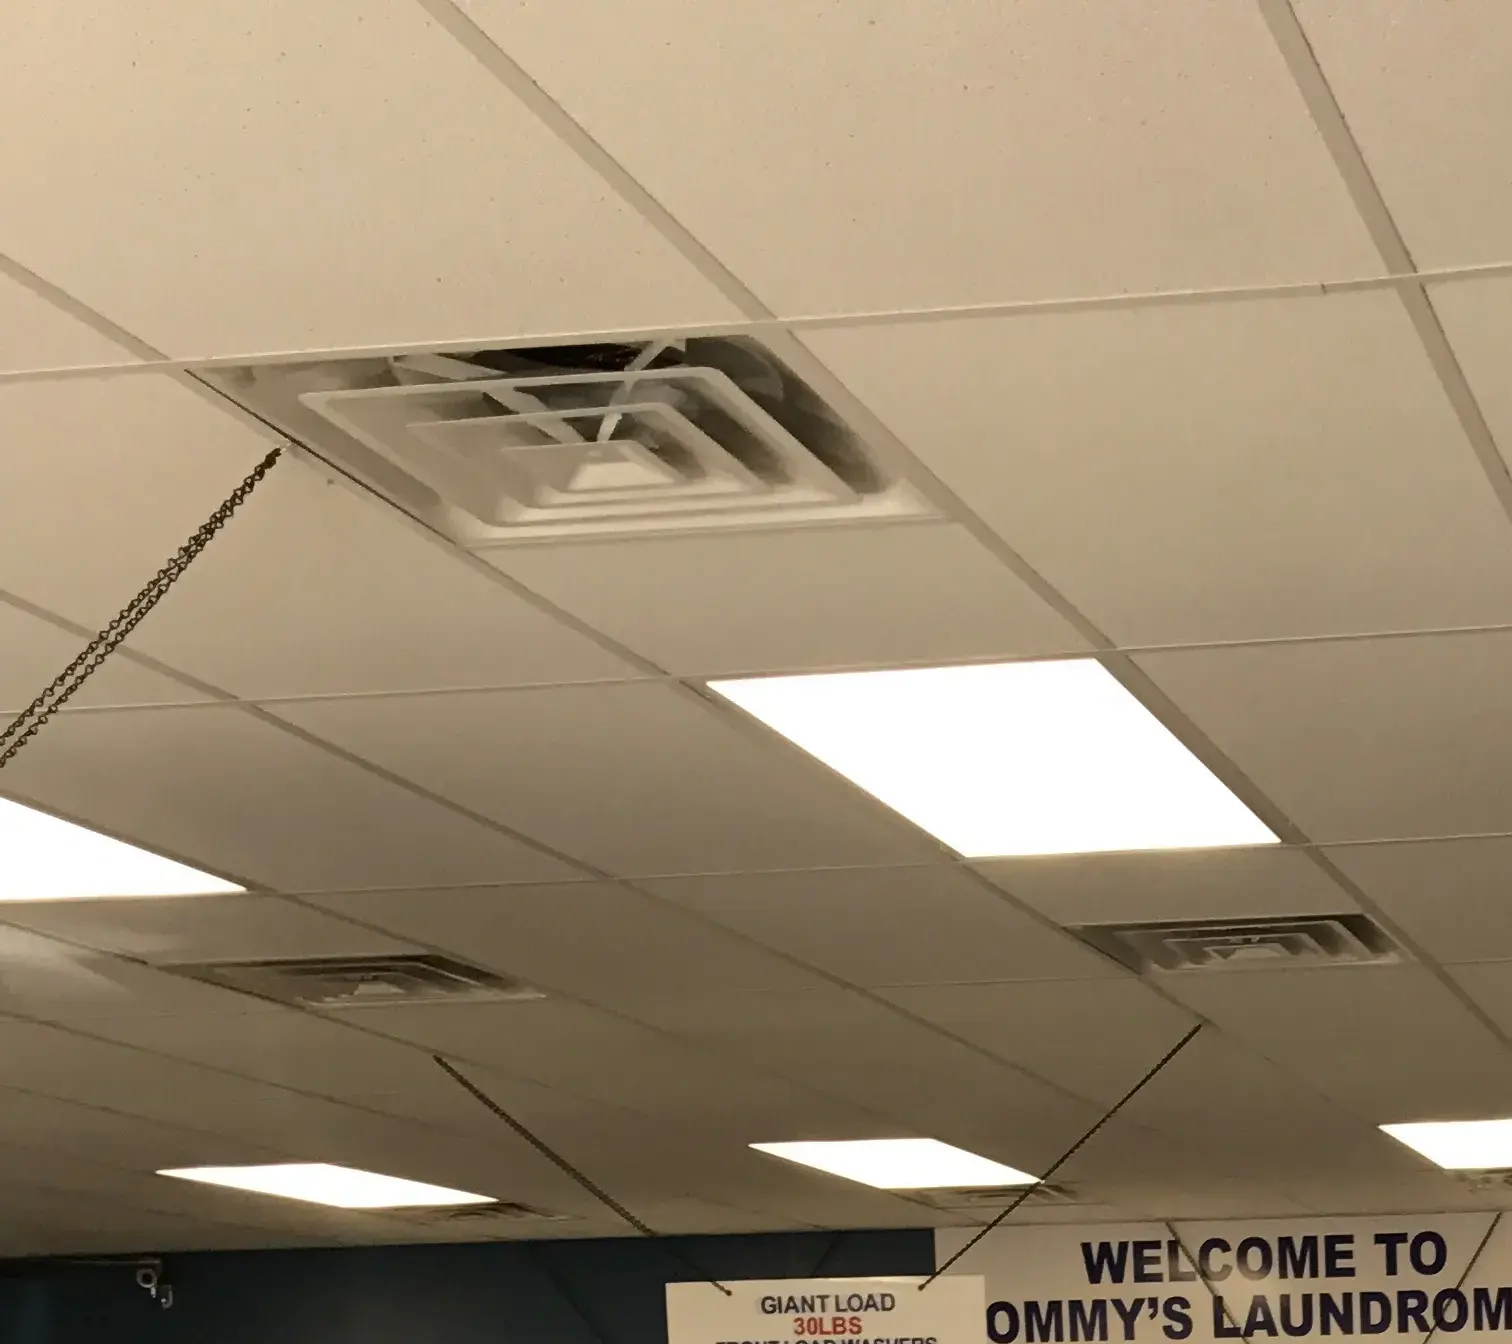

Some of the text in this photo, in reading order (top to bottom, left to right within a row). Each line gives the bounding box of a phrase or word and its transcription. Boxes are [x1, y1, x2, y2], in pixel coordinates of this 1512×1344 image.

[1080, 1232, 1447, 1284] WELCOME TO
[760, 1293, 895, 1314] GIANT LOAD
[986, 1296, 1193, 1344] OMMY'S
[794, 1317, 862, 1335] 30LBS
